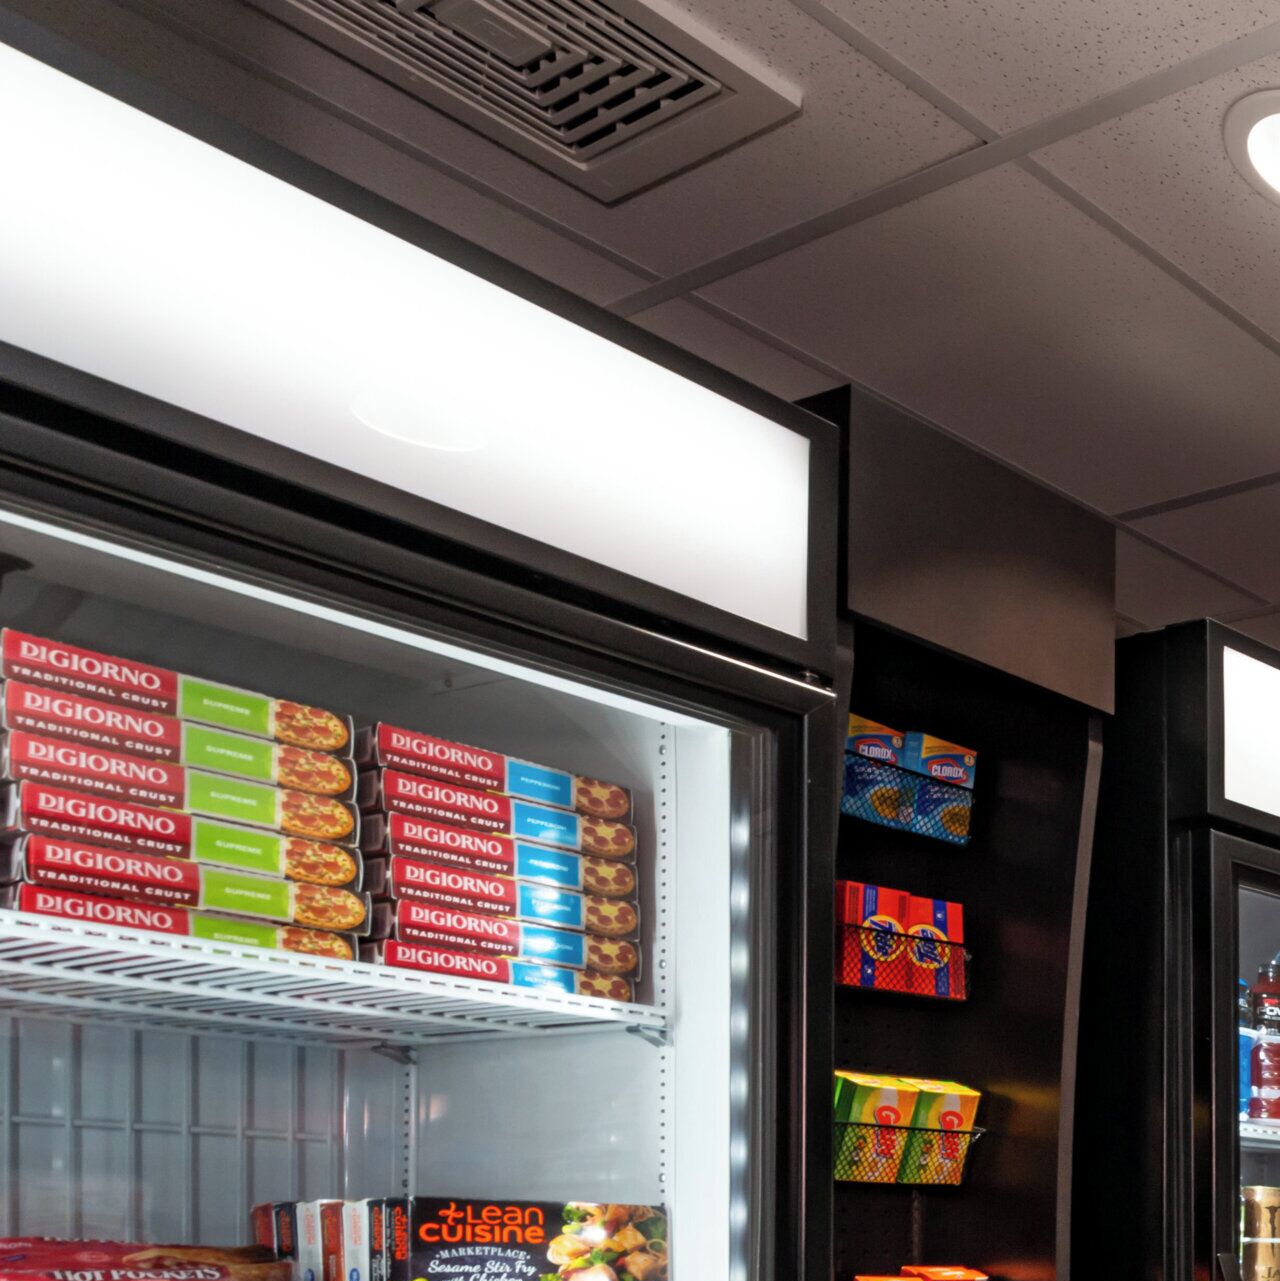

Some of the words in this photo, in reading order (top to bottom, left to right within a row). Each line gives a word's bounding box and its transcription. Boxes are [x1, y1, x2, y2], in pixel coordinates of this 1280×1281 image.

[20, 640, 160, 690] DIGIORNO
[12, 665, 115, 697] TRADITIONAL
[121, 690, 168, 709] CRUST
[24, 690, 164, 739] DIGIORNO
[15, 715, 119, 746] TRADITIONAL
[124, 740, 172, 758] CRUST
[392, 732, 493, 771] DIGIORNO
[859, 744, 893, 761] CLOROX
[28, 741, 168, 786] DIGIORNO
[386, 753, 461, 778] TRADITIONAL
[464, 773, 499, 787] CRUST
[931, 765, 965, 778] CLOROX
[19, 766, 123, 793] TRADITIONAL
[129, 787, 176, 803] CRUST
[397, 778, 499, 813] DIGIORNO
[38, 792, 175, 835] DIGIORNO
[392, 799, 467, 822] TRADITIONAL
[470, 817, 505, 830] CRUST
[30, 817, 131, 844] TRADITIONAL
[137, 837, 183, 852] CRUST
[403, 822, 502, 856] DIGIORNO
[45, 843, 183, 883] DIGIORNO
[398, 843, 471, 865] TRADITIONAL
[475, 858, 509, 871] CRUST
[37, 870, 139, 892] TRADITIONAL
[145, 886, 191, 900] CRUST
[405, 865, 505, 897] DIGIORNO
[36, 893, 172, 929] DIGIORNO
[400, 887, 473, 906] TRADITIONAL
[476, 901, 511, 913] CRUST
[411, 906, 508, 936] DIGIORNO
[405, 928, 477, 945] TRADITIONAL
[481, 940, 514, 952] CRUST
[397, 947, 497, 974] DIGIORNO
[428, 1260, 482, 1274] Sesame
[484, 1260, 511, 1272] Stir
[515, 1260, 537, 1277] Fry
[439, 1246, 527, 1259] MARKETPLACE
[111, 1268, 226, 1281] POCKETS
